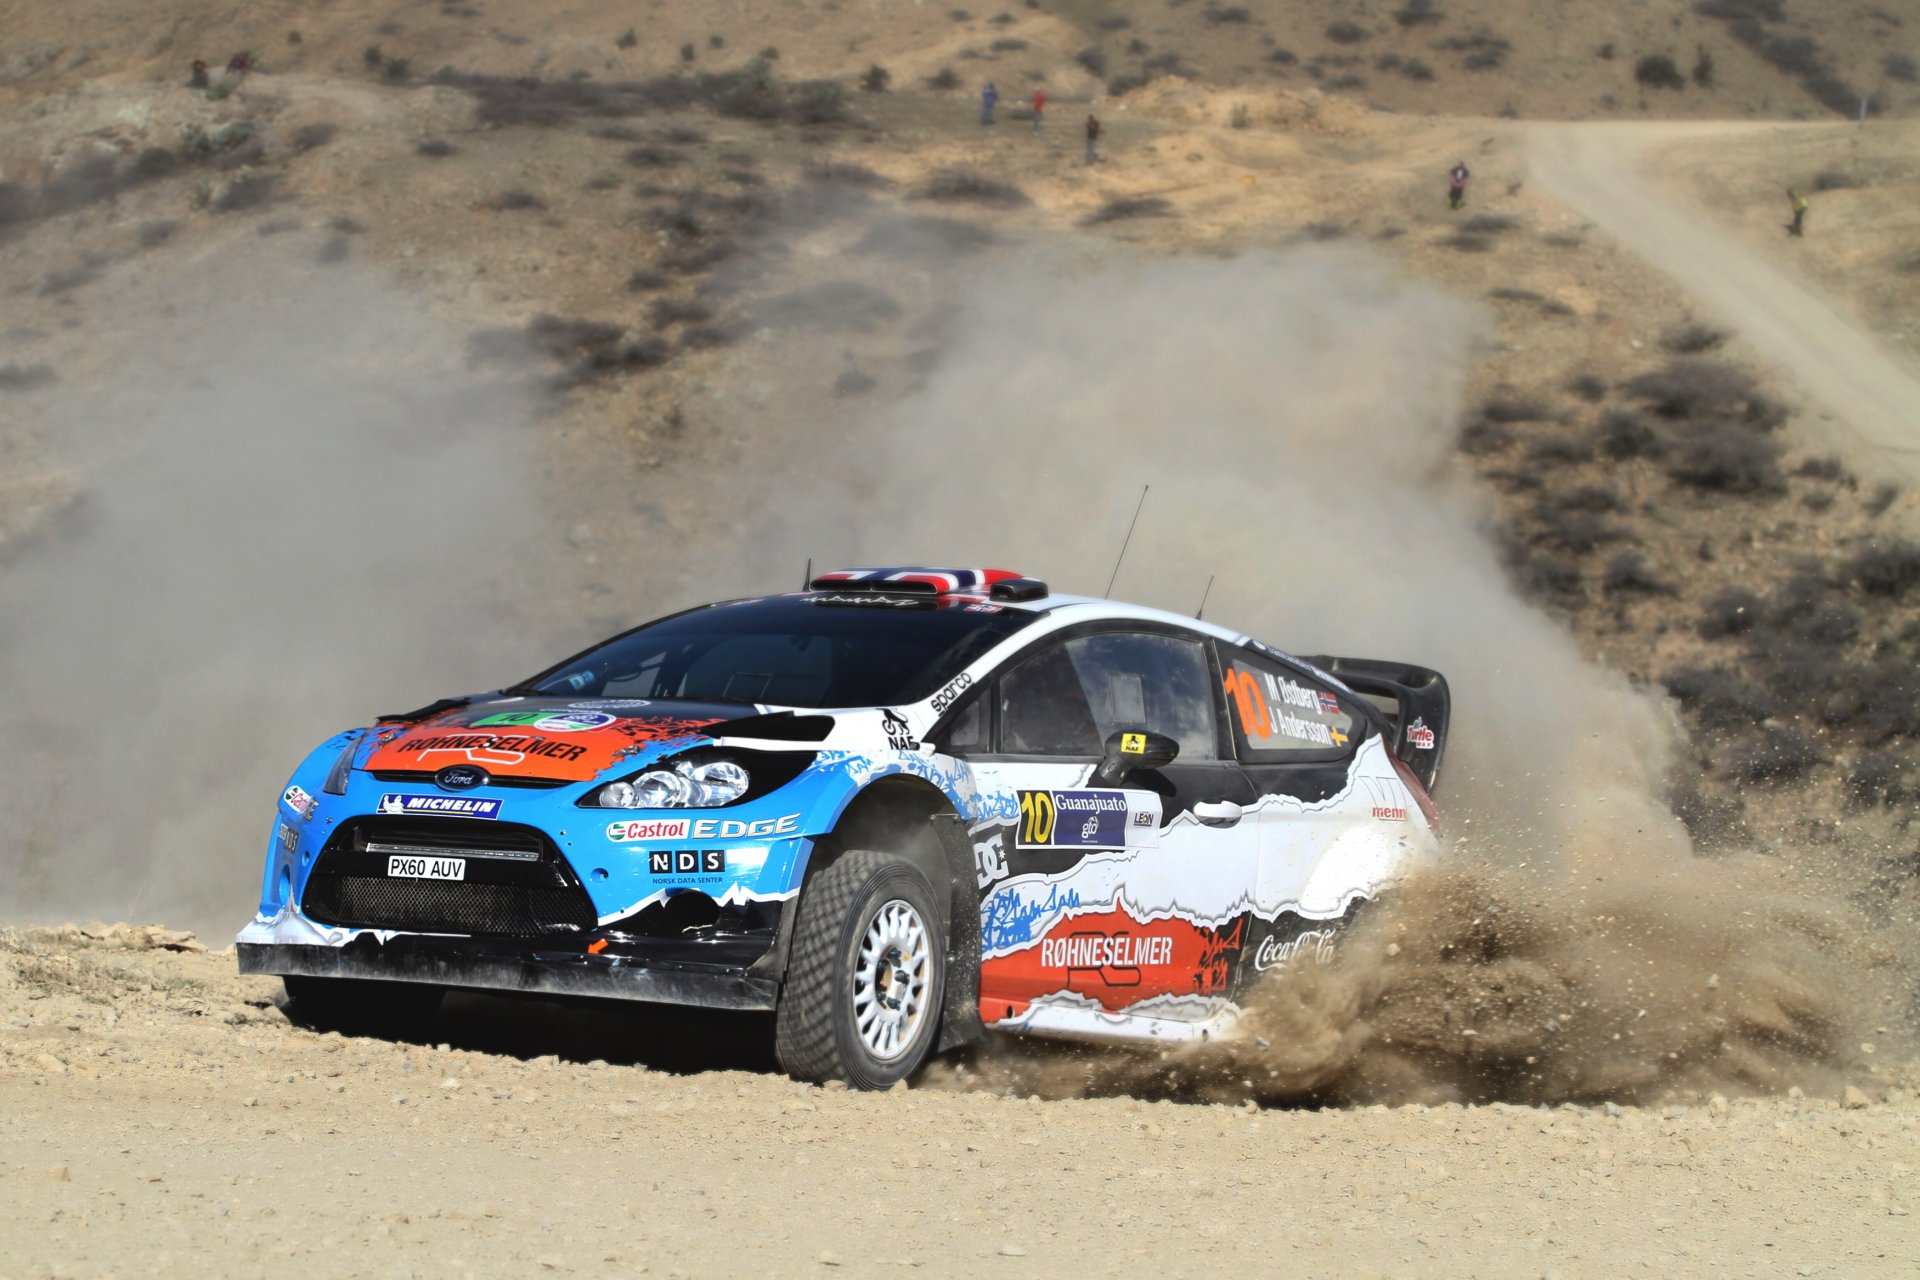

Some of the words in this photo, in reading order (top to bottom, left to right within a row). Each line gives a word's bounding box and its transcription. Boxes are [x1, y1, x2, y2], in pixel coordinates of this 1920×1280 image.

[930, 672, 972, 714] sparco
[1263, 673, 1280, 701] M
[1224, 667, 1271, 740] 10
[1268, 707, 1278, 733] J
[1276, 709, 1333, 744] Andersson
[1407, 726, 1433, 742] Turtle
[444, 771, 474, 785] Ford
[406, 797, 497, 814] MICHELIN
[1054, 794, 1127, 814] Guanajuato
[627, 822, 684, 838] Castrol
[692, 813, 801, 839] EDGE
[1021, 791, 1054, 843] 10
[390, 859, 426, 876] PX60
[430, 860, 463, 877] AUV
[652, 852, 720, 871] NDS
[652, 877, 676, 885] NORSK
[697, 876, 723, 884] SENTER
